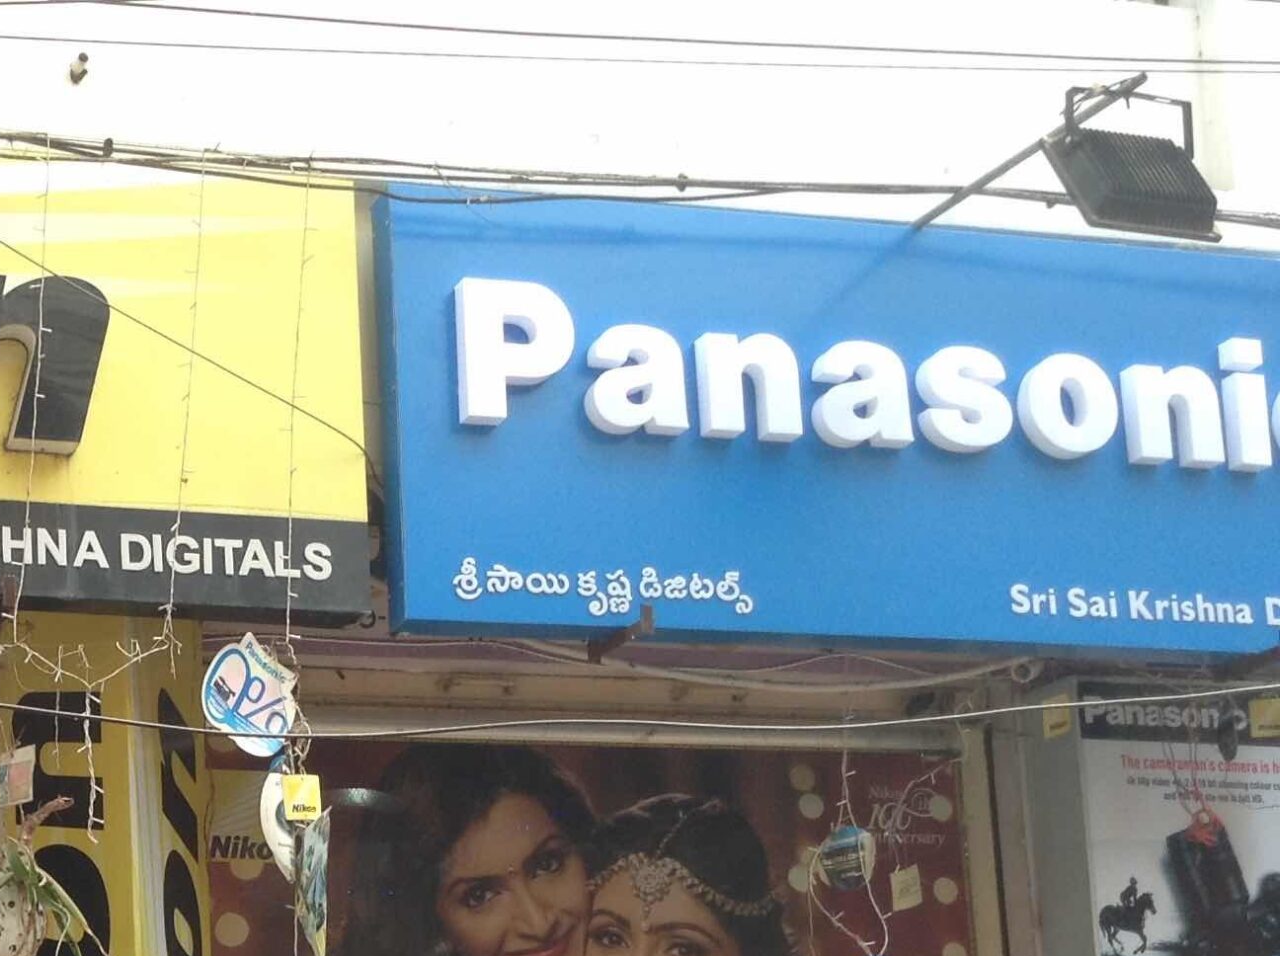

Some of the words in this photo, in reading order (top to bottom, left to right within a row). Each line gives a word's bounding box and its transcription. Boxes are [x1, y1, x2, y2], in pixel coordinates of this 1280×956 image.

[453, 276, 1280, 473] Panasoni
[119, 533, 333, 581] DIGITALS
[452, 557, 484, 600] శ్రీ
[486, 565, 571, 595] సాయి
[575, 568, 632, 616] కృష్ణ
[1009, 584, 1058, 620] Sri
[1066, 588, 1118, 621] Sai
[1126, 590, 1254, 626] Krishna
[1082, 696, 1249, 731] Panasonc
[210, 834, 274, 862] Niko
